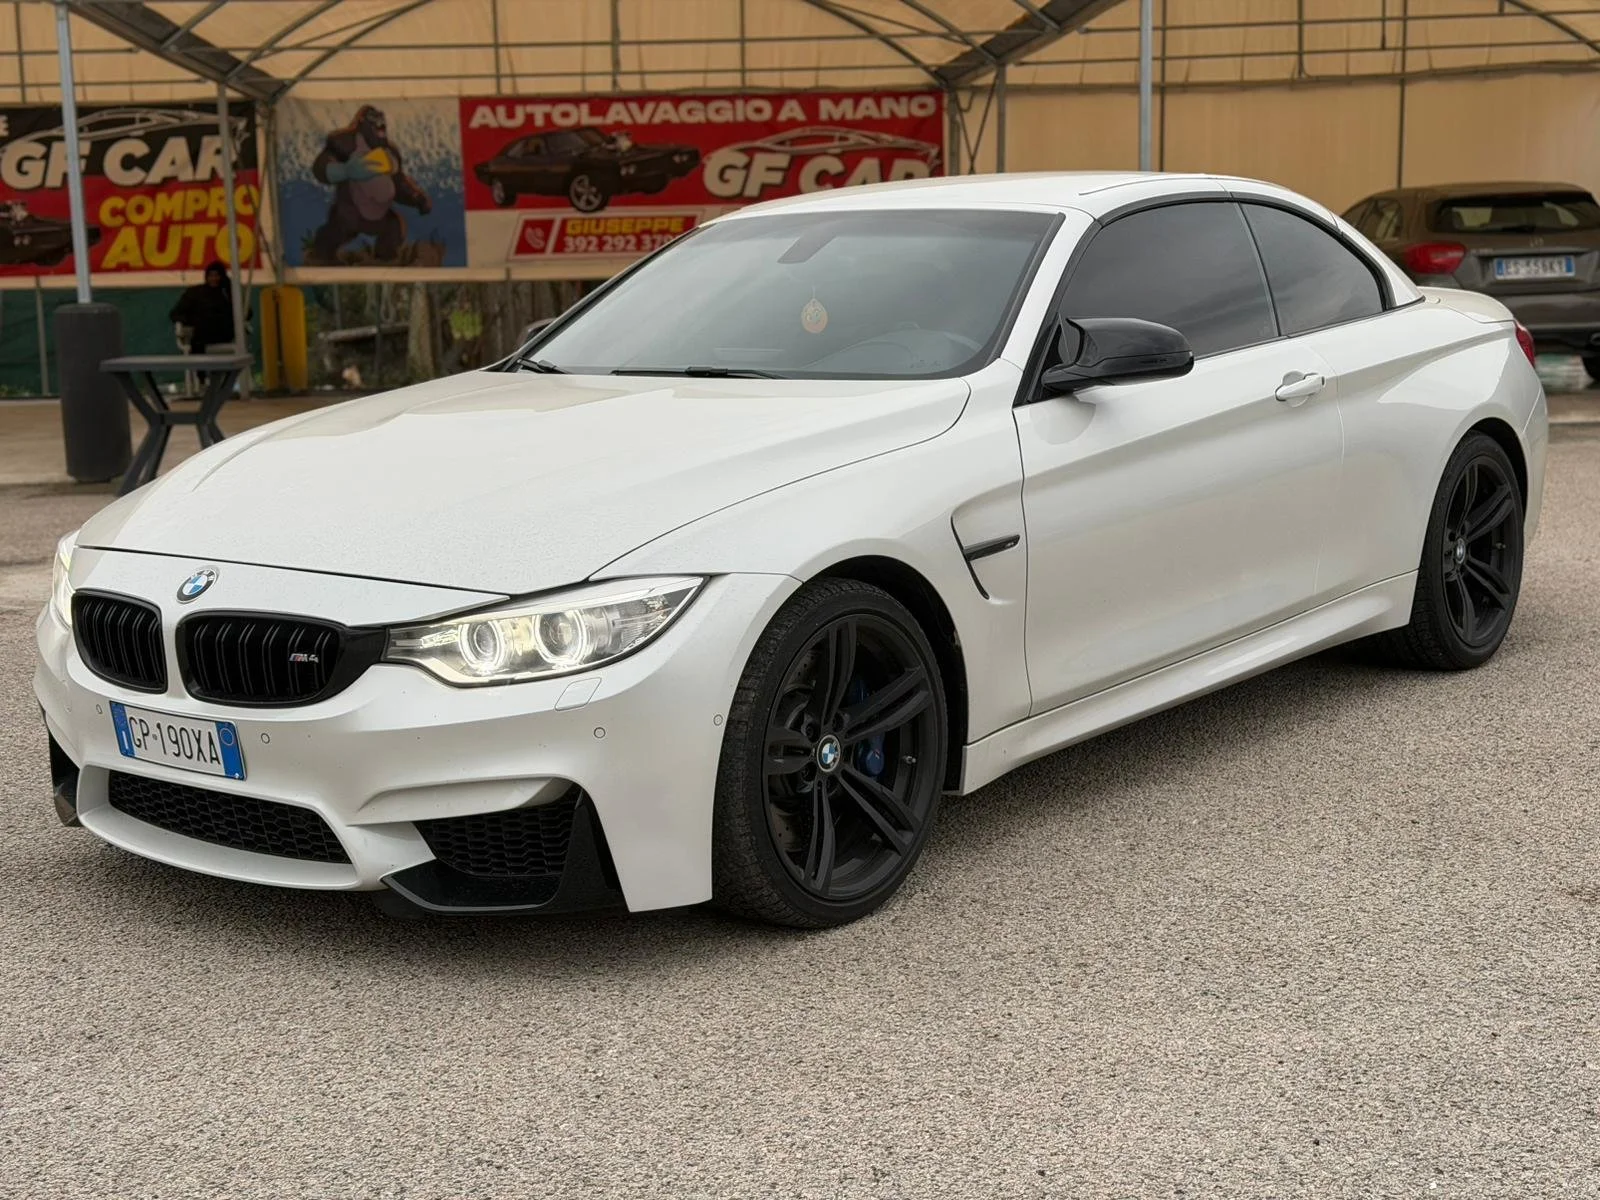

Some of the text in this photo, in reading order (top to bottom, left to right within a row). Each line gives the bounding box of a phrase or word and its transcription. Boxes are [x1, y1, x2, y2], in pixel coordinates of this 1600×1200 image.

[469, 95, 937, 129] AUTOLAVAGGIO A MANO
[0, 135, 238, 190] GF CAR
[703, 150, 791, 198] GF
[100, 184, 260, 228] COMPRO
[565, 217, 684, 235] GIUSEPPE
[101, 222, 256, 269] AUTO
[563, 236, 598, 252] 392
[601, 235, 636, 251] 292
